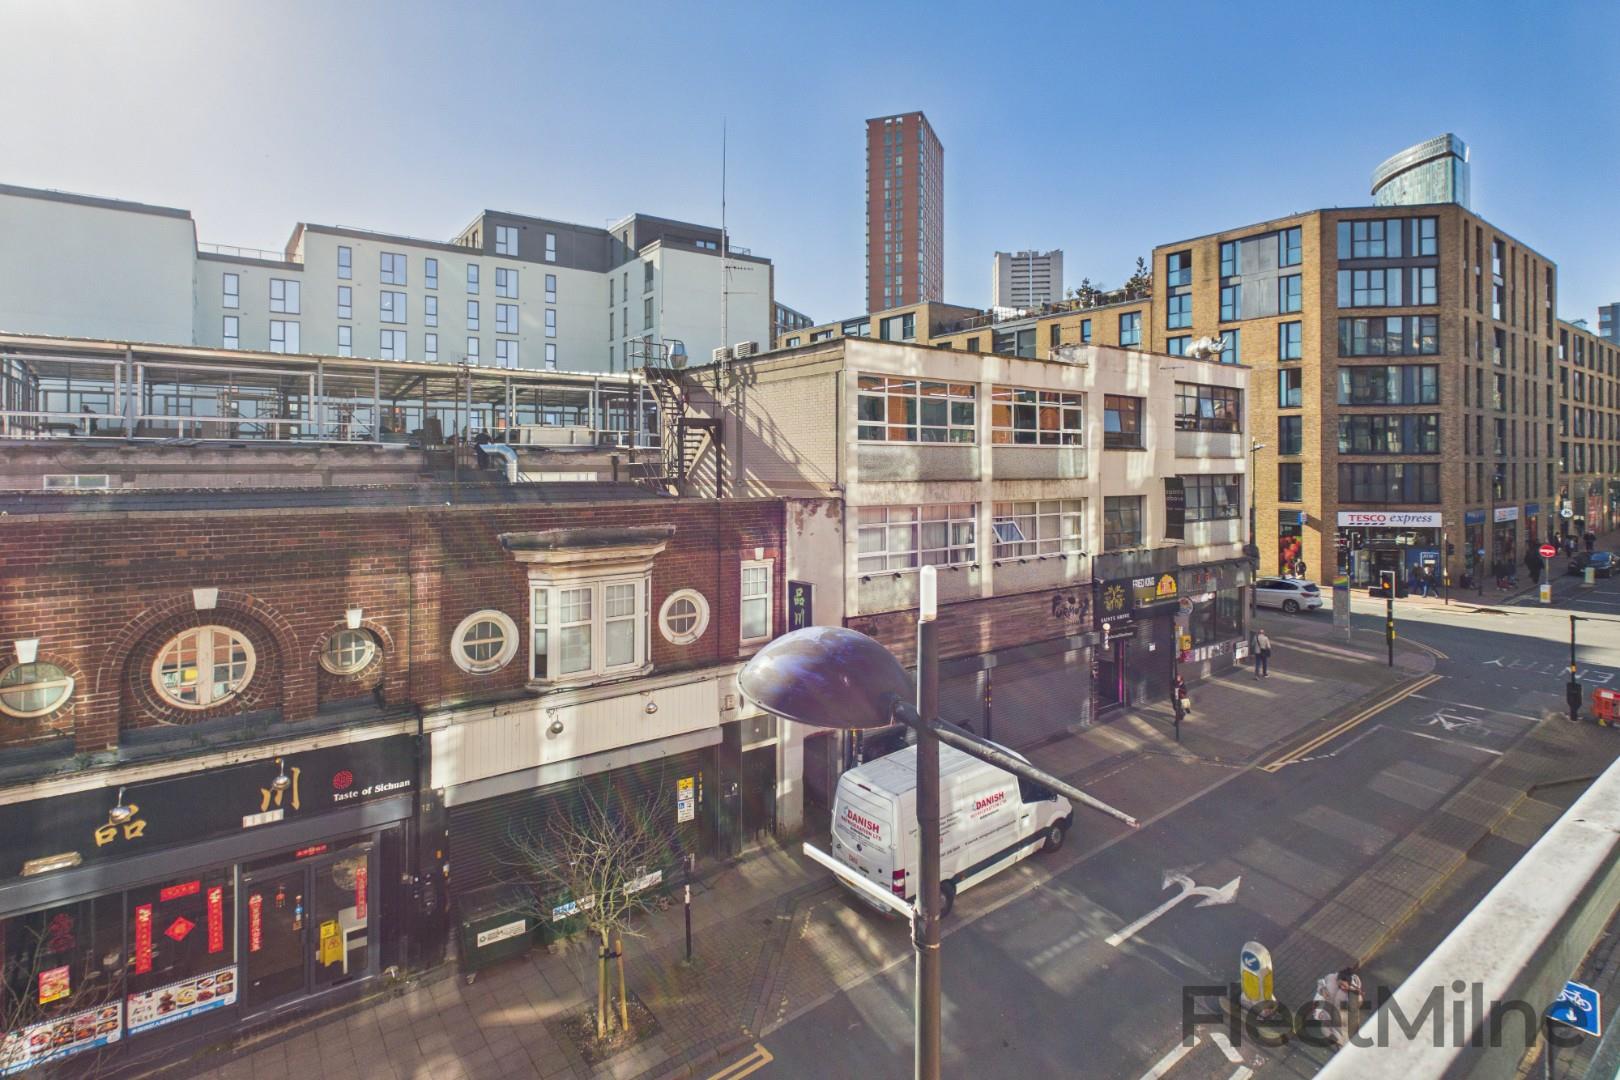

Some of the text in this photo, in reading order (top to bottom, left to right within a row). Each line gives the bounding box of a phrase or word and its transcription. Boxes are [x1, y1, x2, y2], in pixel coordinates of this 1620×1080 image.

[1348, 514, 1433, 525] TESCO express
[333, 779, 411, 802] Taste of Sichuan
[975, 791, 1005, 810] DANISH
[847, 809, 881, 834] DANISH
